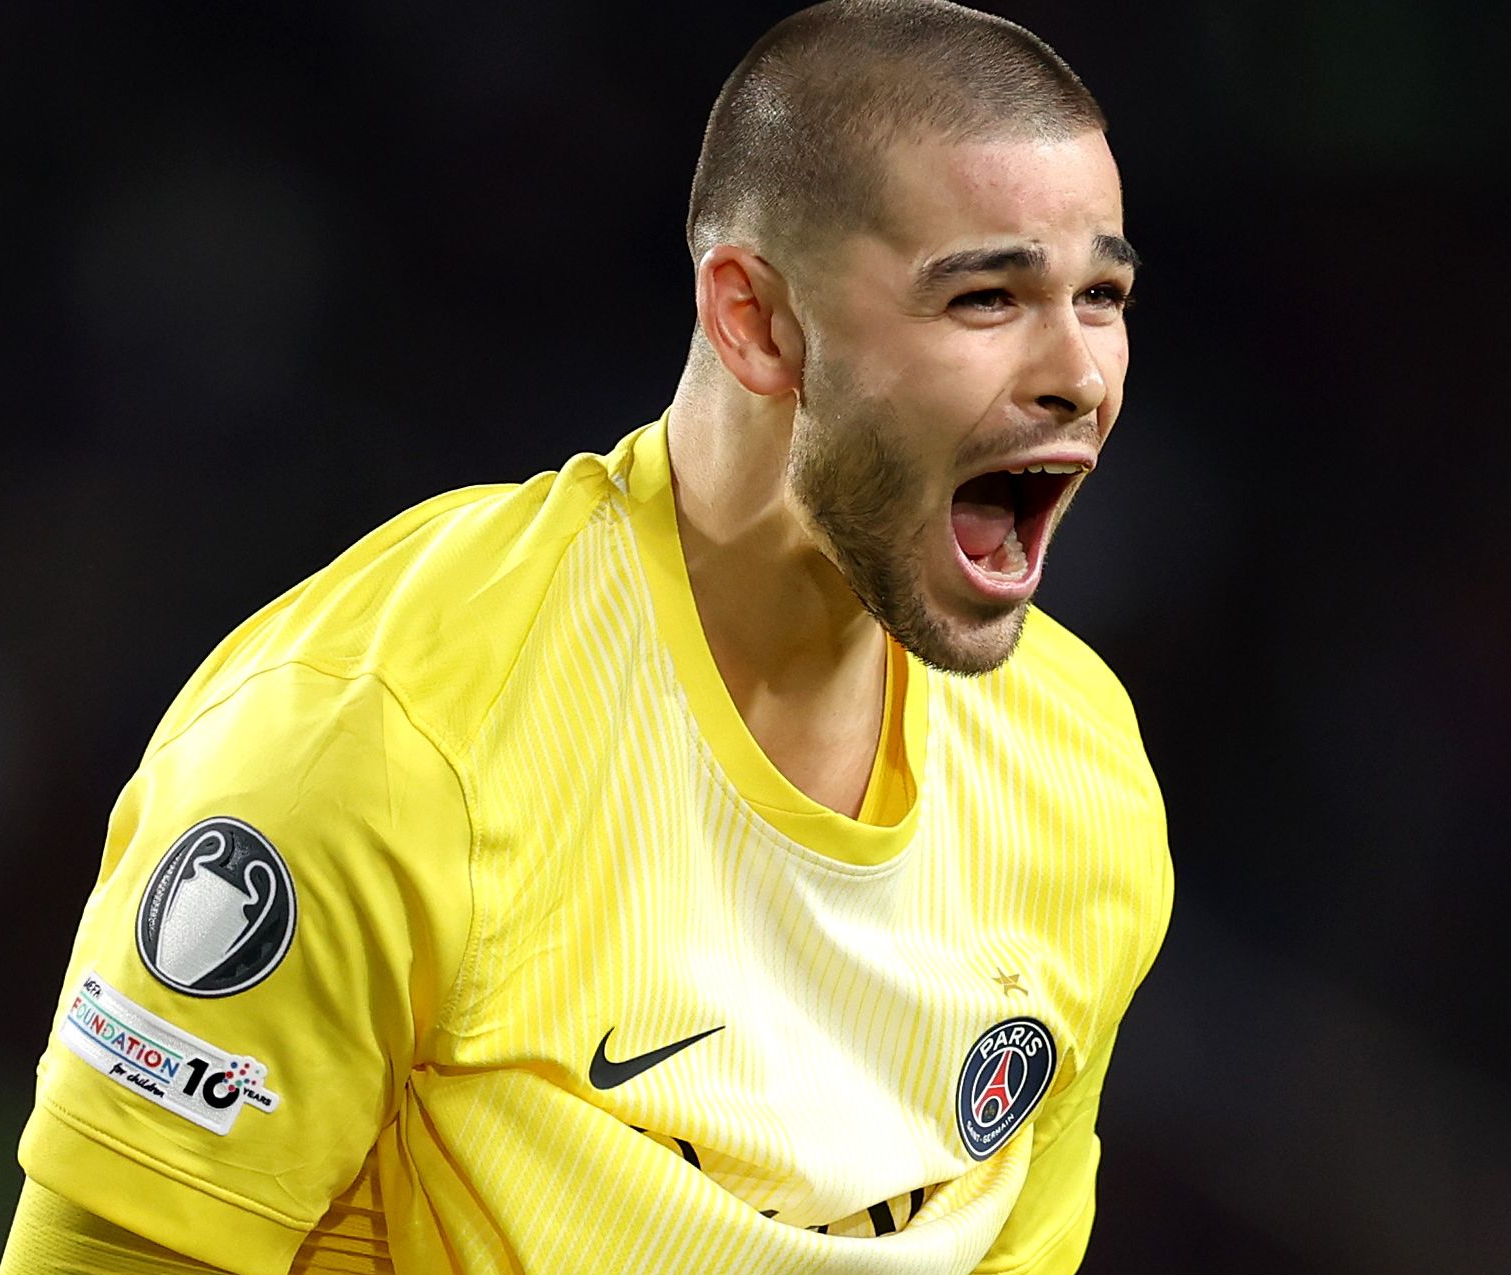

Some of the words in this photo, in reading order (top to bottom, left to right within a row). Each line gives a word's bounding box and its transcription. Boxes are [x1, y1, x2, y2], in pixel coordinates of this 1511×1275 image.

[70, 997, 180, 1078] FOUNDATION
[979, 1026, 1043, 1060] PARIS
[109, 1062, 127, 1075] for
[127, 1073, 165, 1098] children
[183, 1058, 240, 1109] 10
[243, 1087, 272, 1107] YEARS
